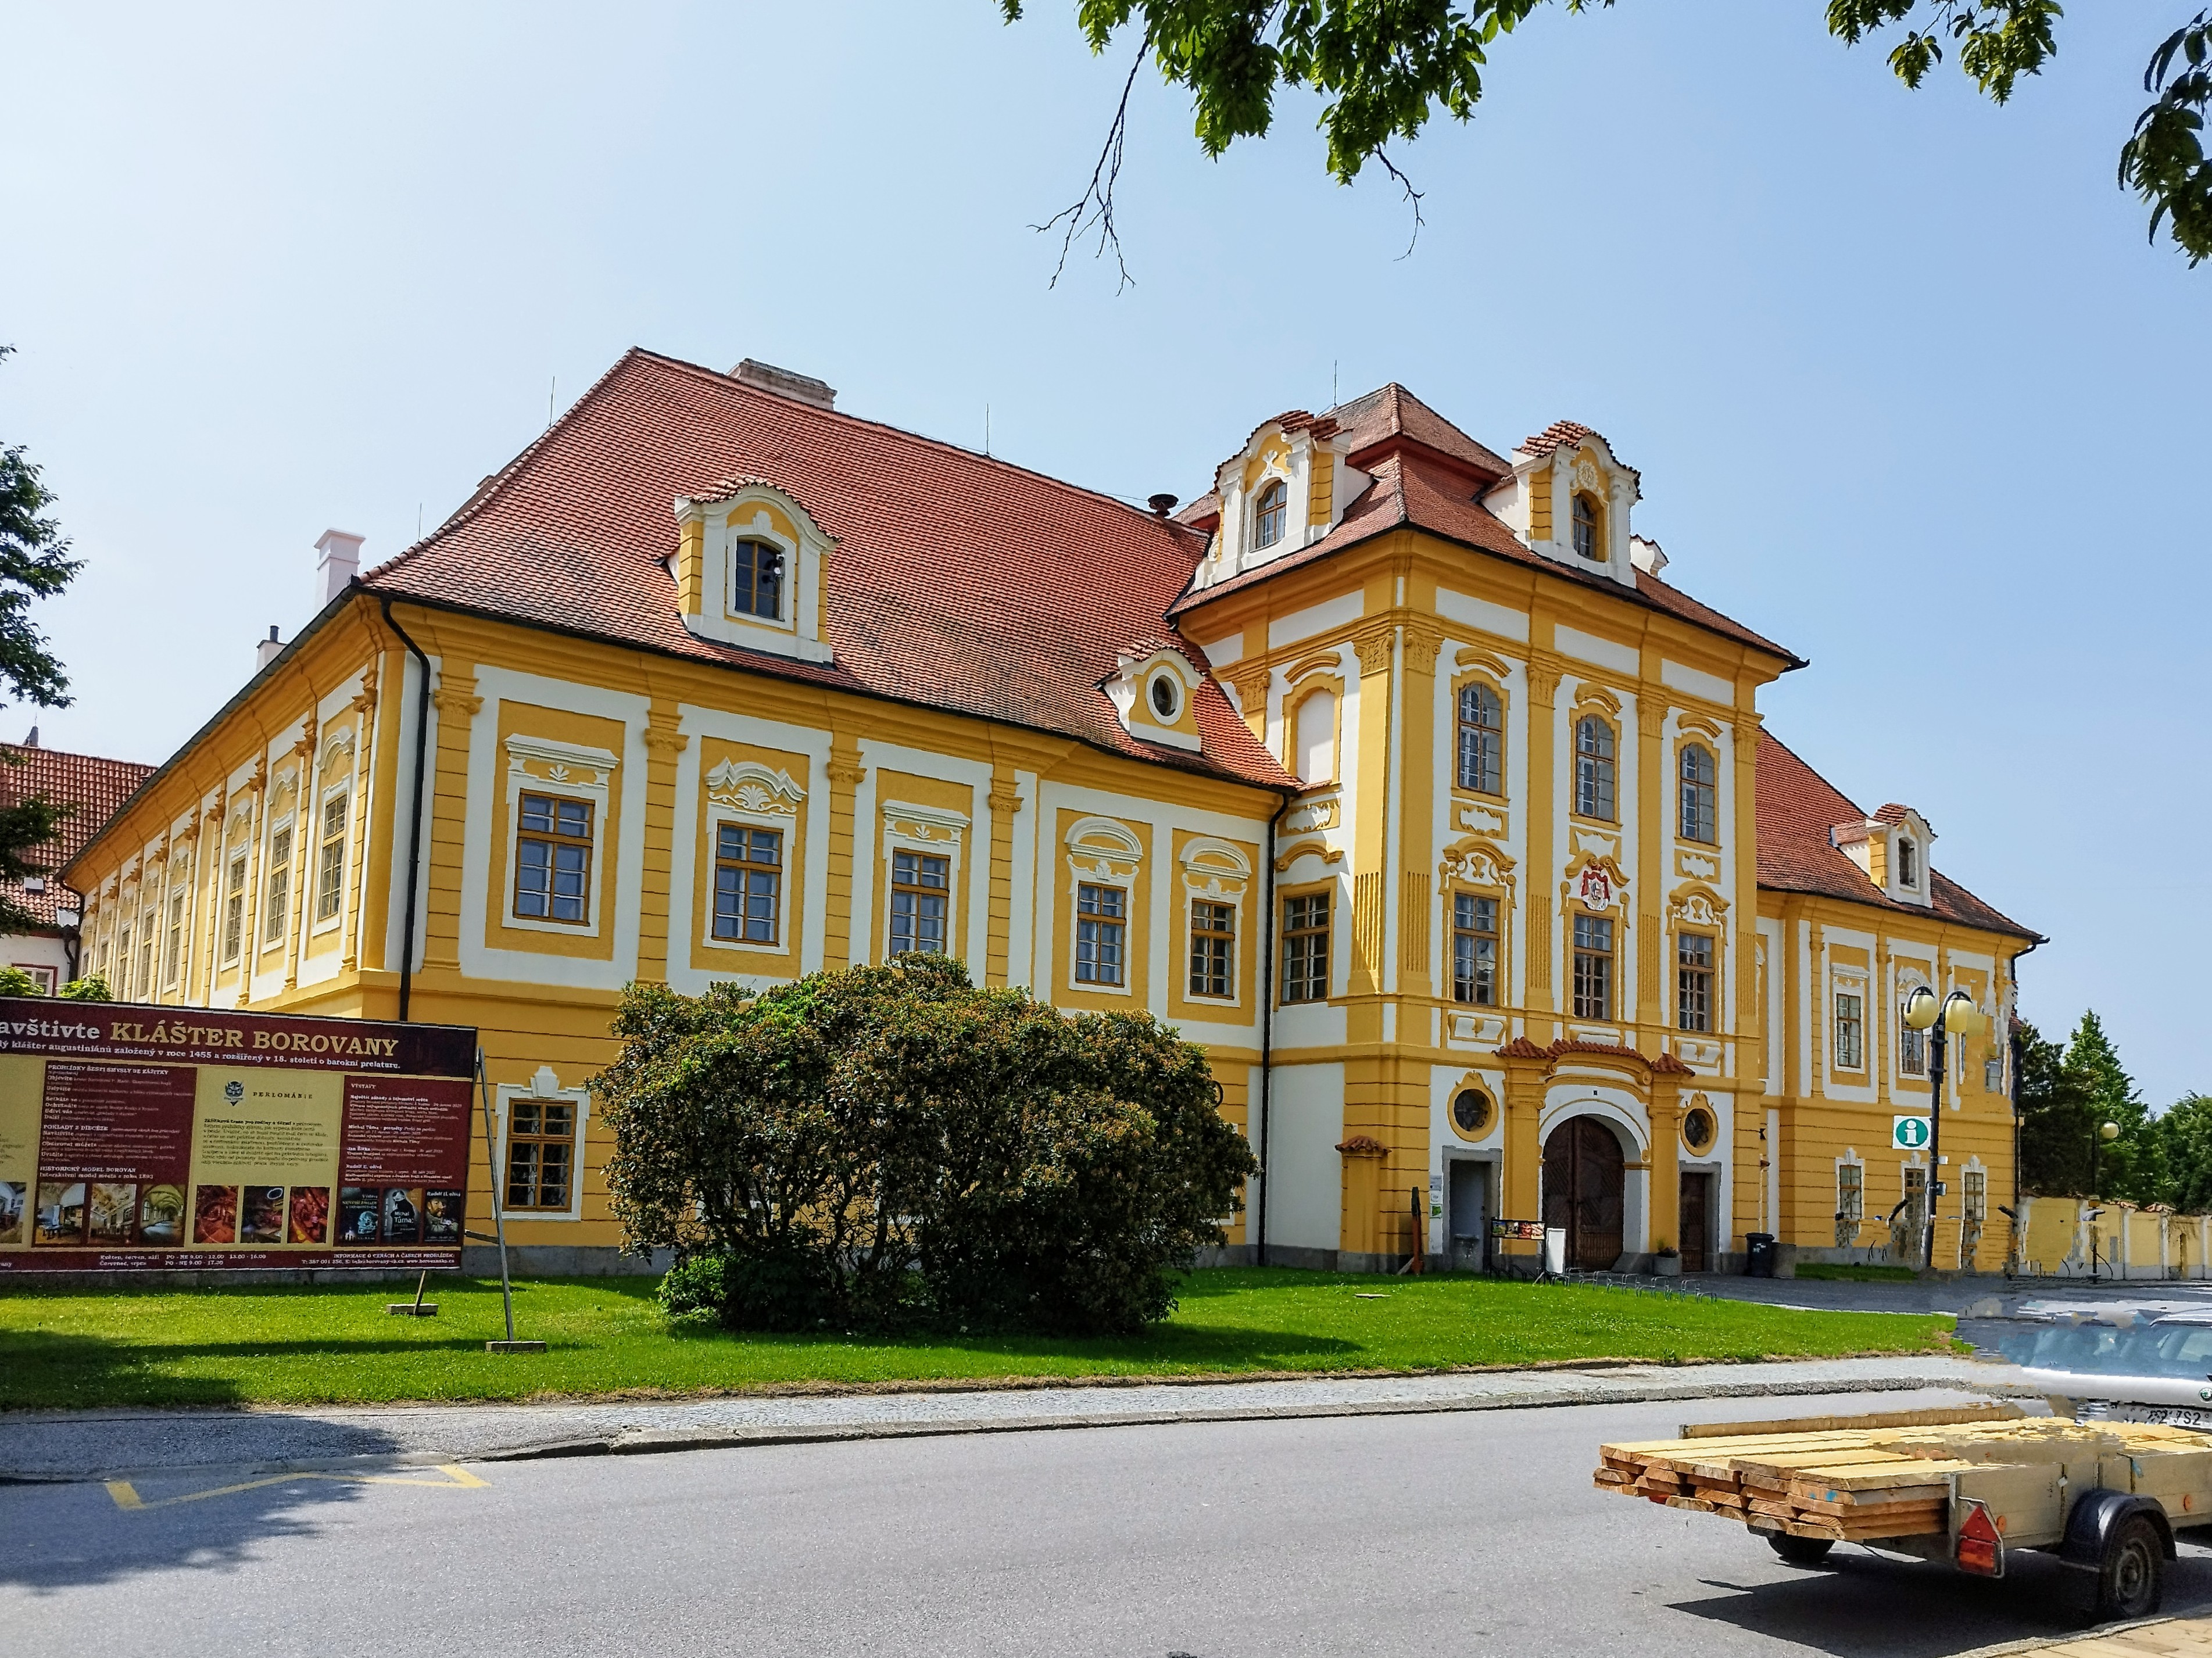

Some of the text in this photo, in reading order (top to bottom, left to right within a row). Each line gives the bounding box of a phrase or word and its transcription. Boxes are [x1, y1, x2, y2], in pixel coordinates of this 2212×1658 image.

[110, 1019, 244, 1048] KLÁŠTER
[252, 1030, 399, 1057] BOROVANY
[12, 1040, 46, 1050] klášter
[49, 1044, 112, 1054] augustiniánů
[114, 1047, 155, 1057] založený
[189, 1051, 212, 1059] 1455
[223, 1052, 263, 1063] rozšířený
[290, 1057, 317, 1065] století
[327, 1058, 358, 1066] barokní
[360, 1060, 400, 1069] prelaturu.
[252, 1091, 313, 1100] PEKLOMÁNIE
